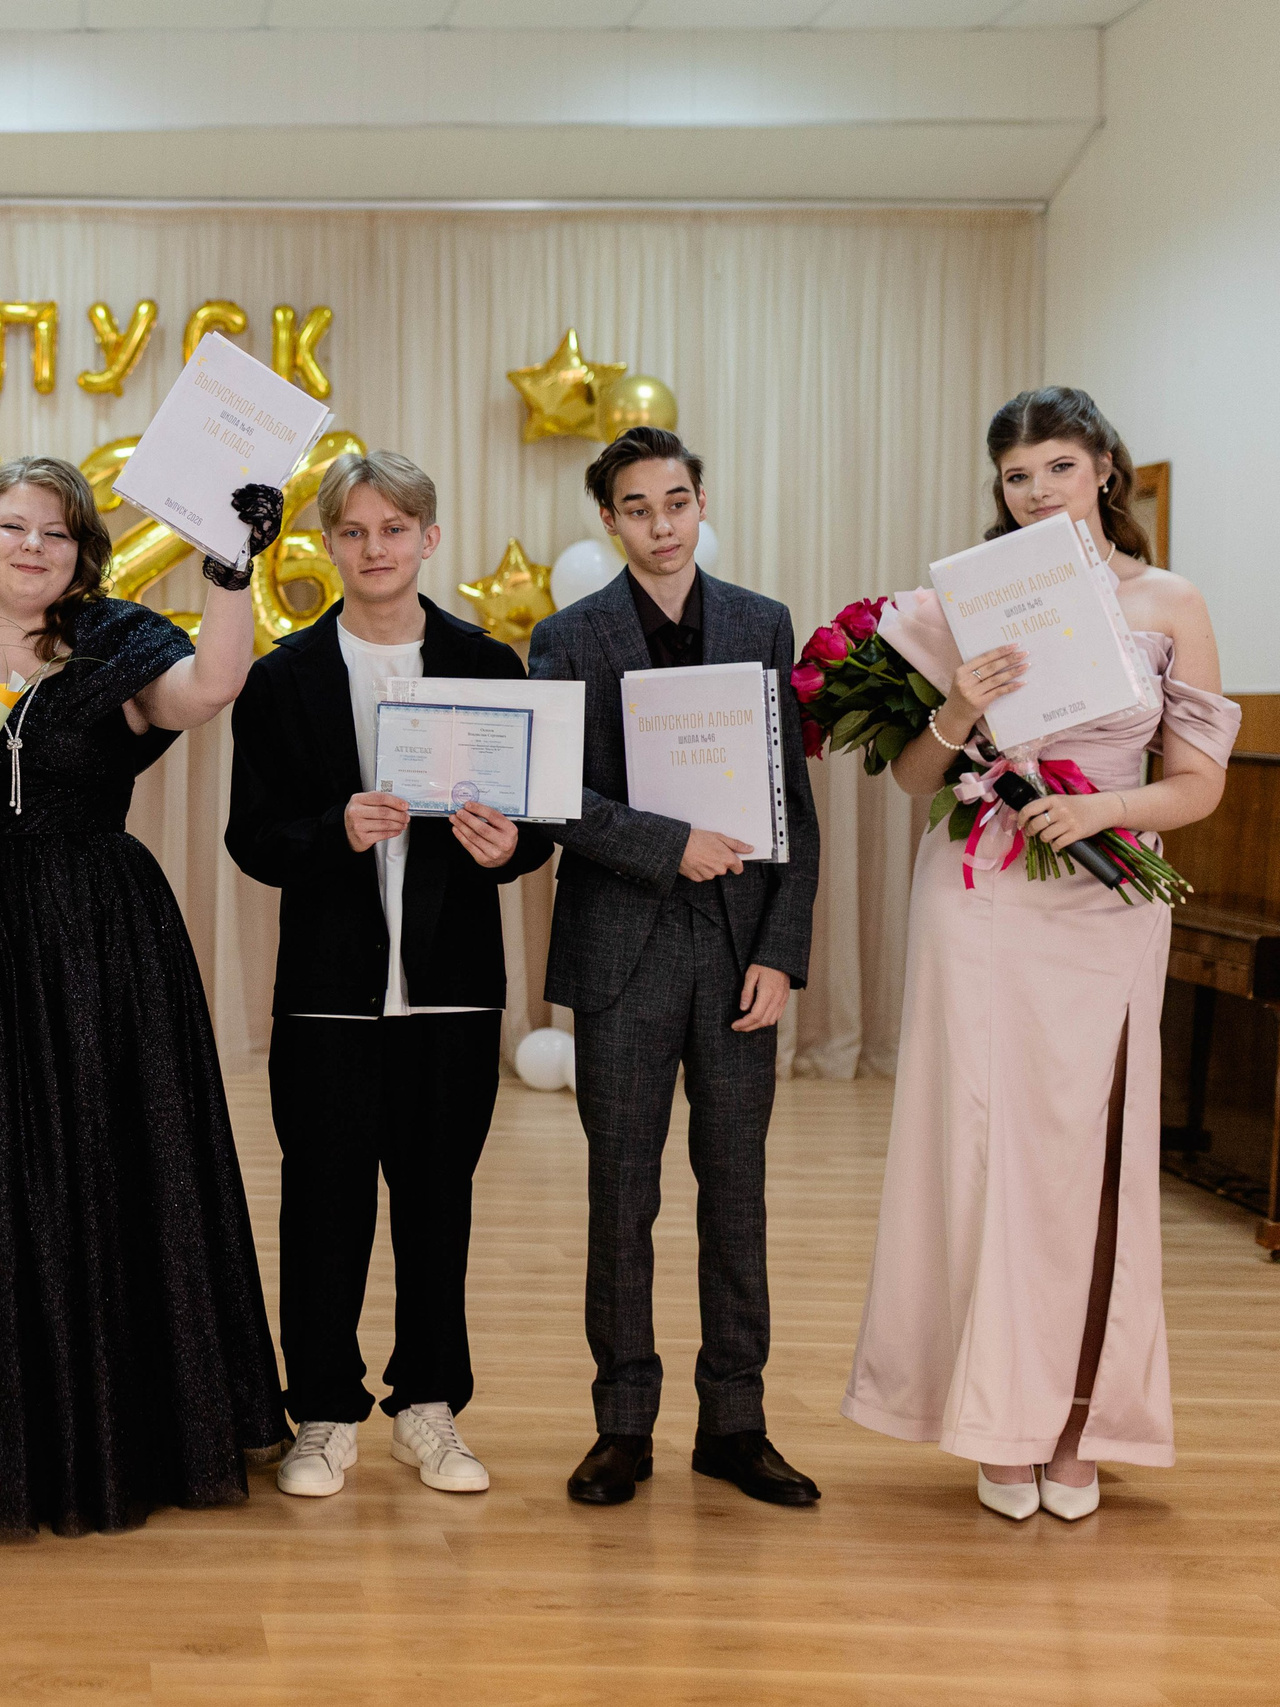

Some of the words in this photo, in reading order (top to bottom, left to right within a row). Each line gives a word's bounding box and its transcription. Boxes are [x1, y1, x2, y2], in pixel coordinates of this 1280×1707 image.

[194, 371, 256, 417] ВЫПУСКНОЙ
[254, 410, 297, 444] АЛЬБОМ
[220, 410, 240, 428] ШКОЛА
[202, 417, 221, 437] 11А
[220, 428, 255, 459] КЛАСС
[164, 497, 189, 518] ВЫПУСК
[958, 579, 1027, 618] ВЫПУСКНОЙ
[1028, 562, 1077, 591] АЛЬБОМ
[1004, 604, 1026, 618] ШКОЛА
[1000, 623, 1022, 642] 11А
[1022, 608, 1060, 634] КЛАСС
[638, 711, 704, 732] ВЫПУСКНОЙ
[708, 709, 754, 726] АЛЬБОМ
[1042, 706, 1068, 723] ВЫПУСК
[678, 734, 700, 744] ШКОЛА
[670, 750, 688, 766] 11А
[692, 748, 726, 765] КЛАСС
